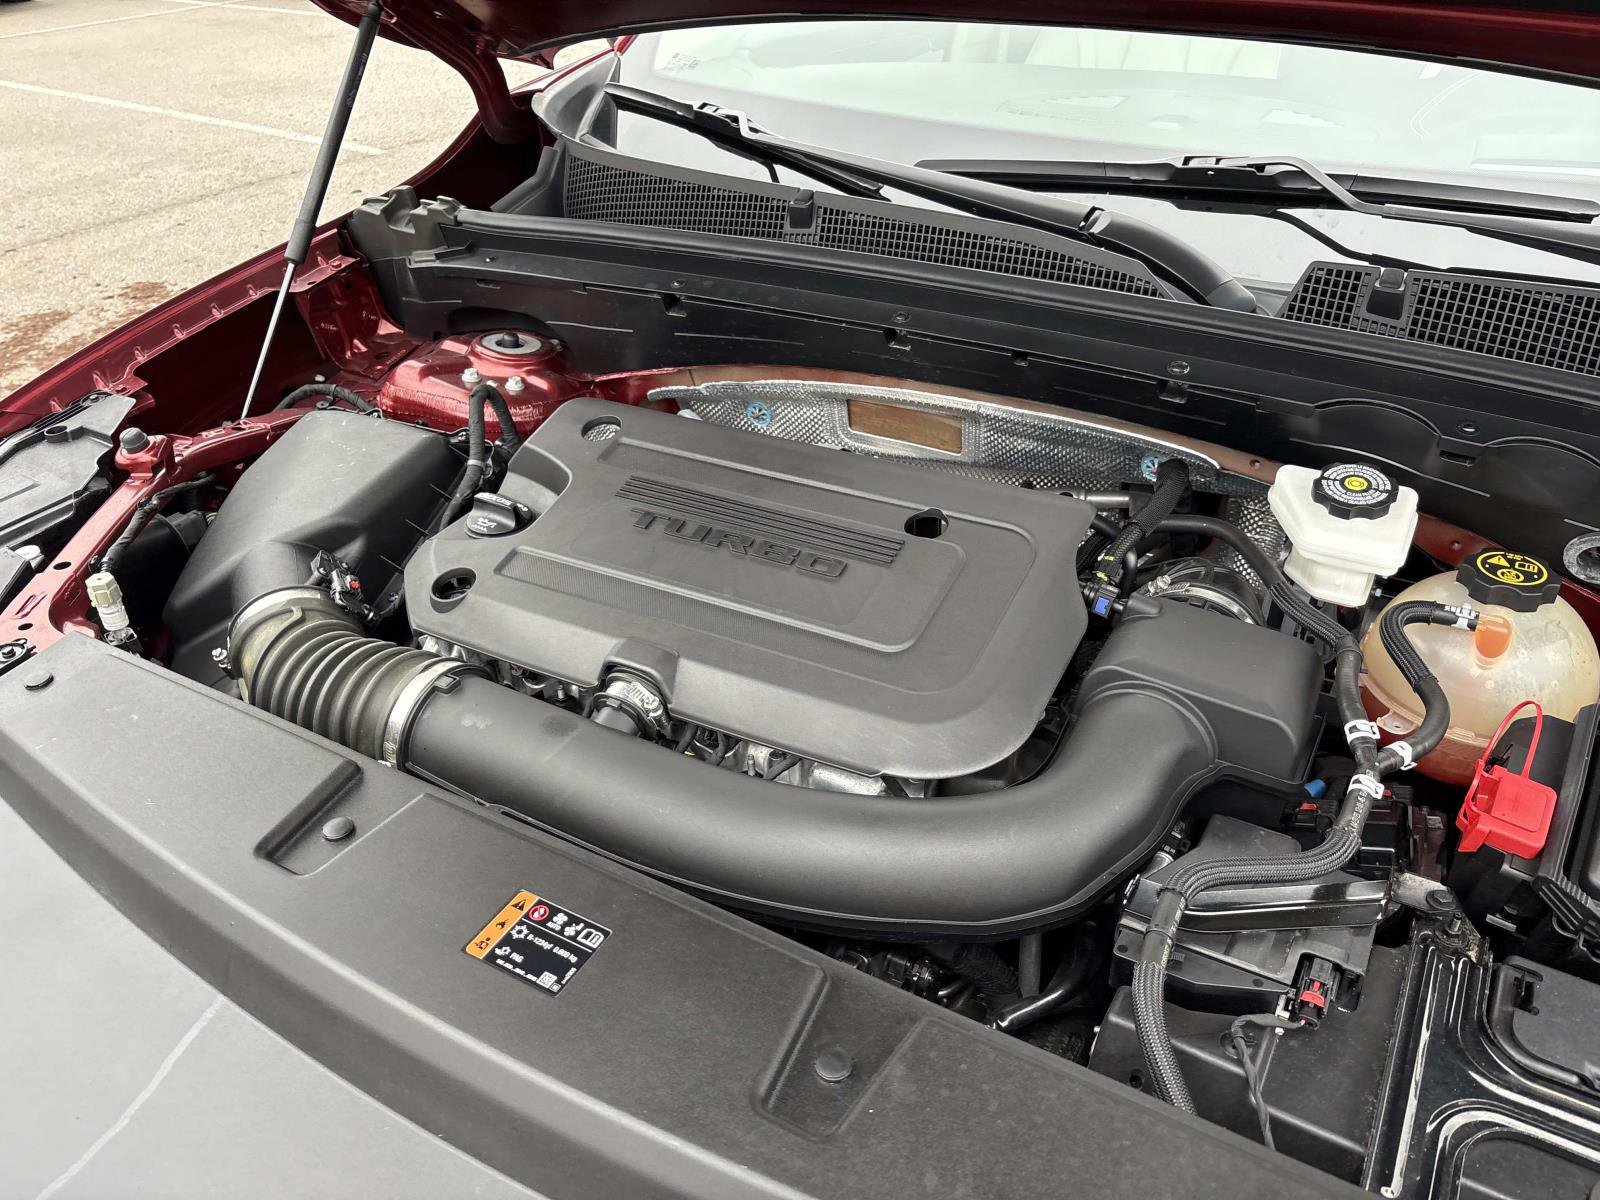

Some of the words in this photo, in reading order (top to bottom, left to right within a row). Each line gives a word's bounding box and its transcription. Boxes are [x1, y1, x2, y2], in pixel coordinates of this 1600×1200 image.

[630, 508, 848, 578] TURBO
[546, 921, 562, 931] AUTO
[509, 951, 525, 964] PAG
[526, 933, 554, 951] R-1234yf
[569, 952, 578, 964] kg
